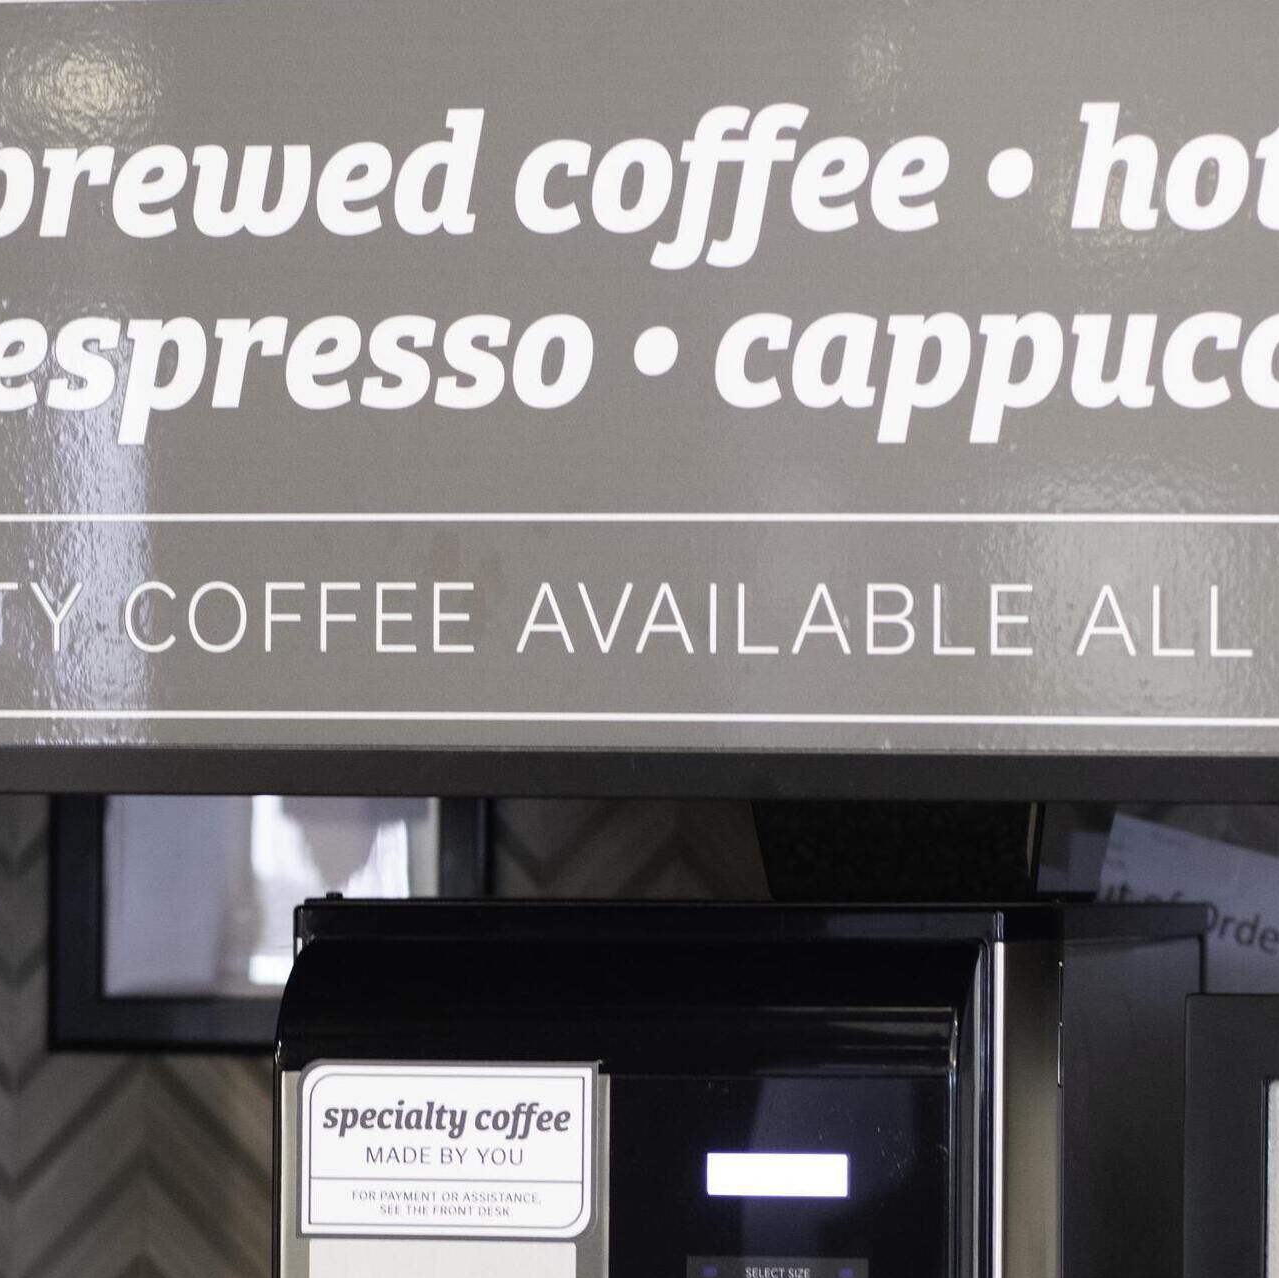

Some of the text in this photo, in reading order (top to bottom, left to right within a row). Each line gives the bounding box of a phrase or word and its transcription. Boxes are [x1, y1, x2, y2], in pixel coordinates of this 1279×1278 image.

[513, 102, 950, 270] coffee
[124, 580, 477, 654] COFFEE
[516, 581, 1035, 657] AVAILABLE
[1076, 584, 1254, 660] ALL
[322, 1100, 571, 1141] specialty coffee
[365, 1146, 524, 1167] MADE BY YOU
[352, 1190, 377, 1202] FOR
[380, 1190, 437, 1202] PAYMENT
[441, 1191, 459, 1203] OR
[380, 1204, 400, 1215] SEE
[406, 1204, 427, 1216] THE
[432, 1205, 473, 1217] FRONT
